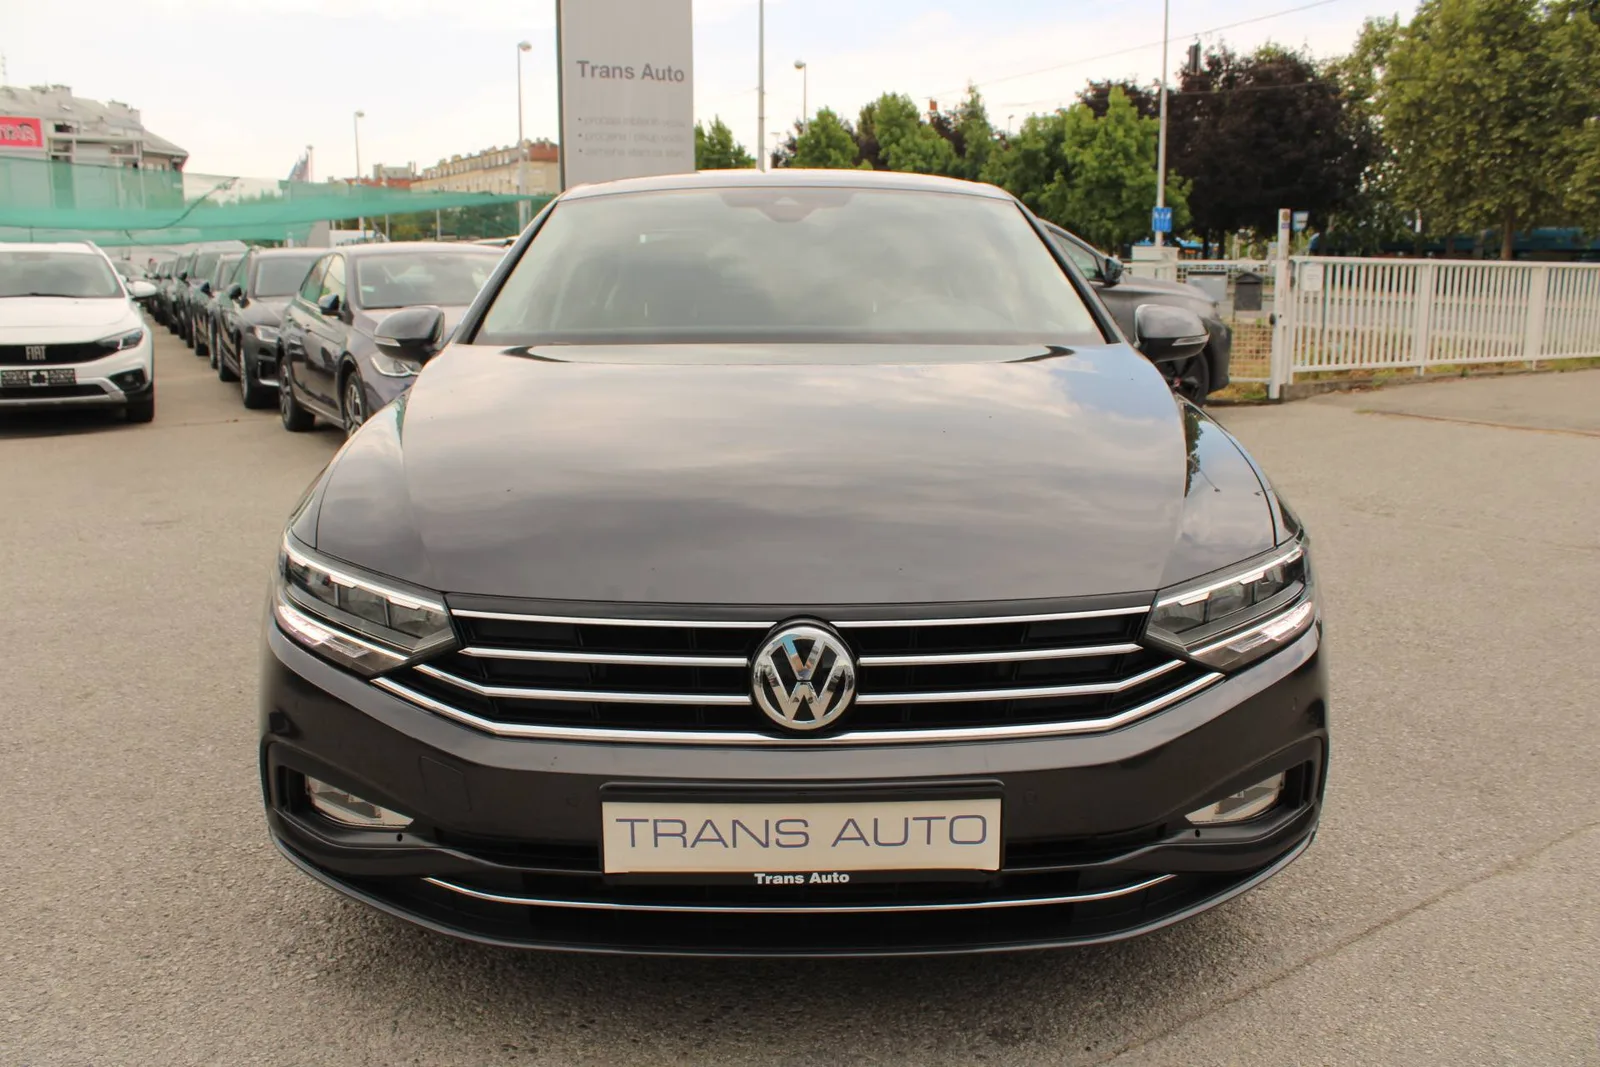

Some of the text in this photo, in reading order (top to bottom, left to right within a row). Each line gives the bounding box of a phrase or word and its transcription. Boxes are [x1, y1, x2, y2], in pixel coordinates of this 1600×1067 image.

[577, 61, 685, 82] Trans Auto
[25, 345, 47, 361] FIAT
[755, 628, 852, 729] VW
[616, 814, 987, 848] TRANS AUTO
[754, 871, 850, 885] Trans Auto
